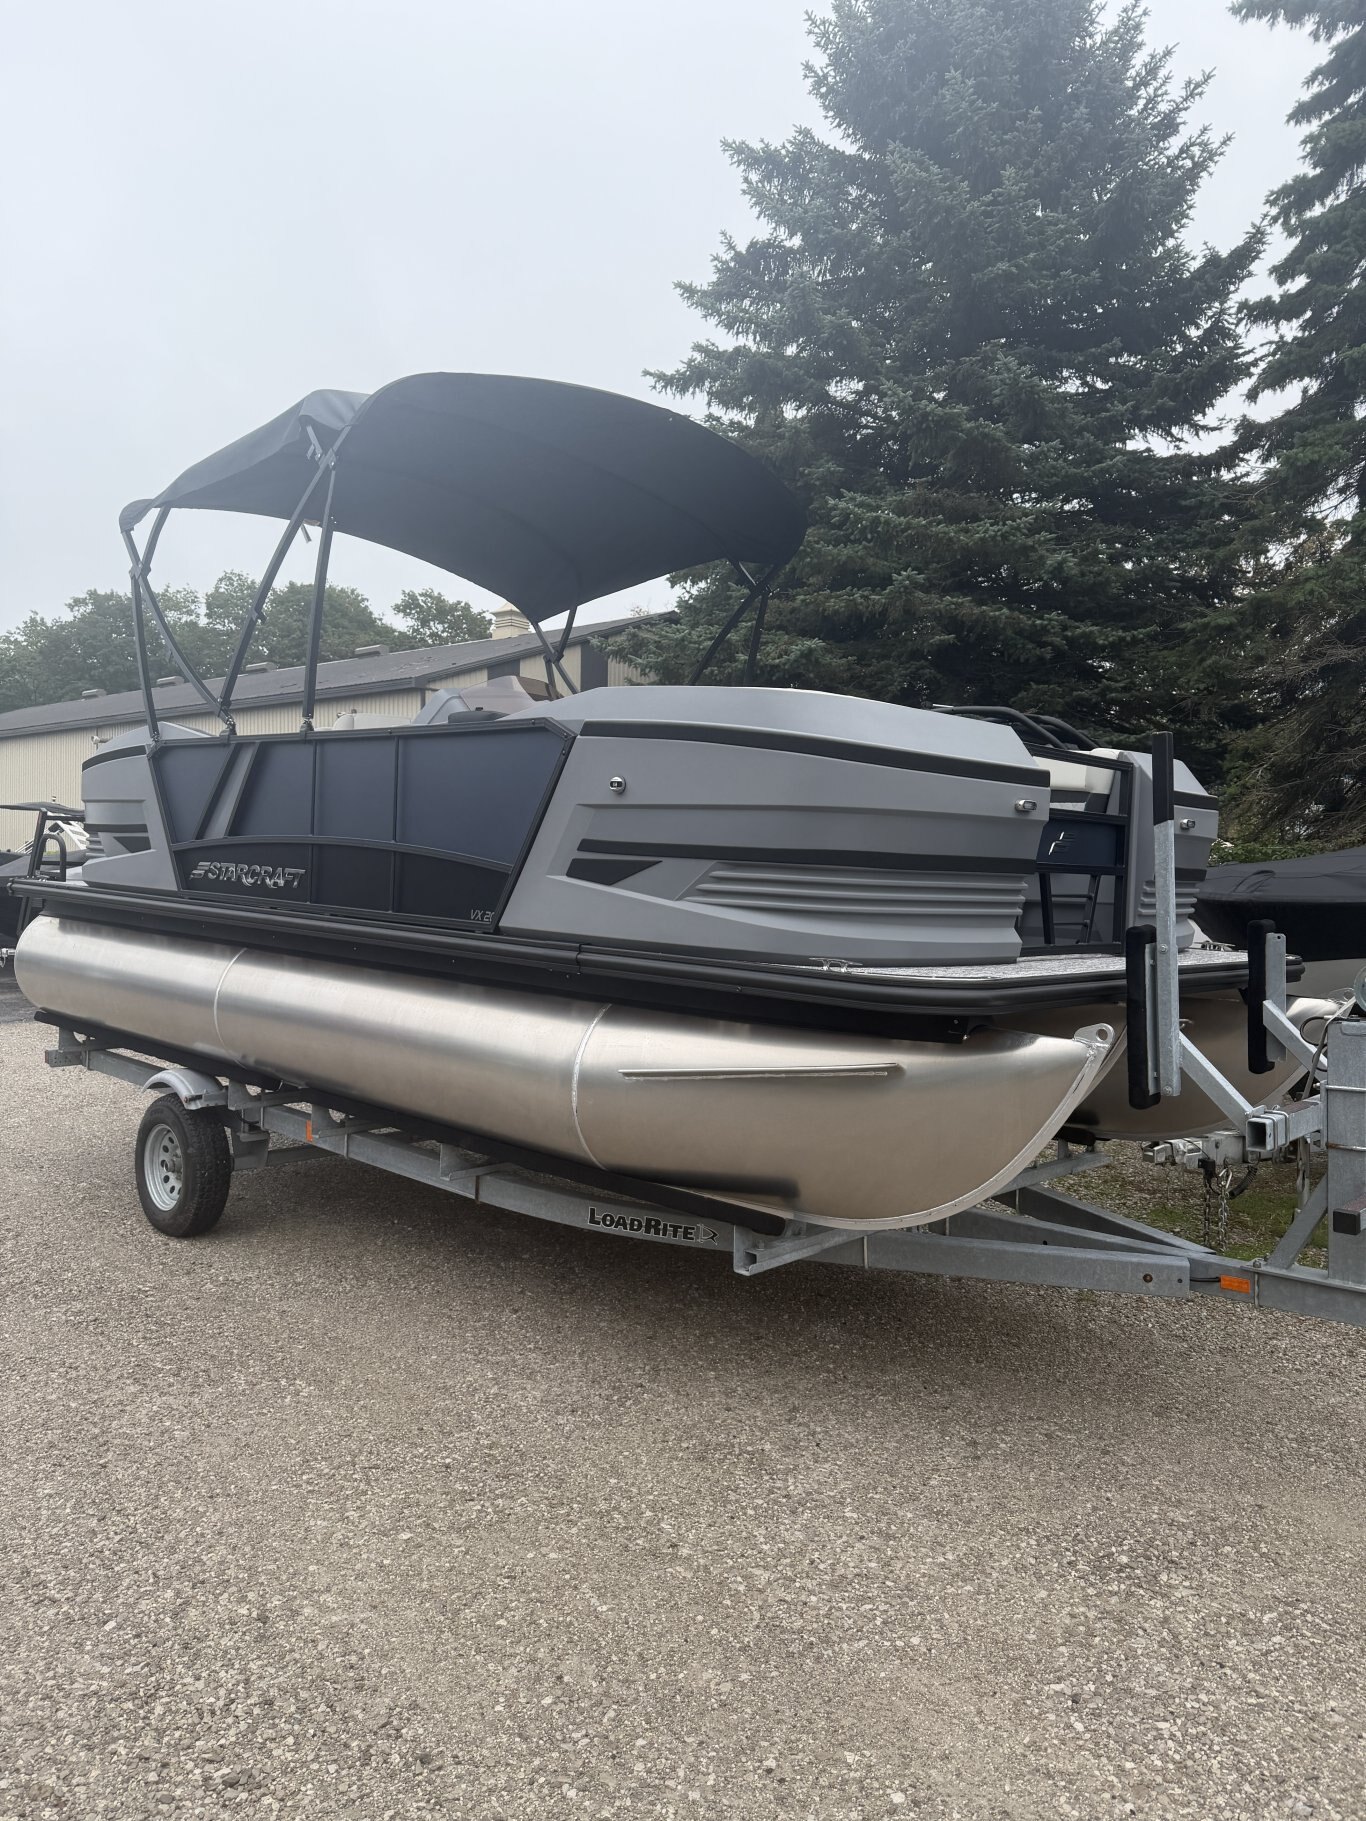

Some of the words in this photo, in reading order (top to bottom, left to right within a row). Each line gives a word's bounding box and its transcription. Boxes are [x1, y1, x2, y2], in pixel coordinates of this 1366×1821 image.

[207, 861, 306, 889] STARCRAFT
[470, 909, 484, 921] VX
[588, 1206, 697, 1242] LOADRITE
